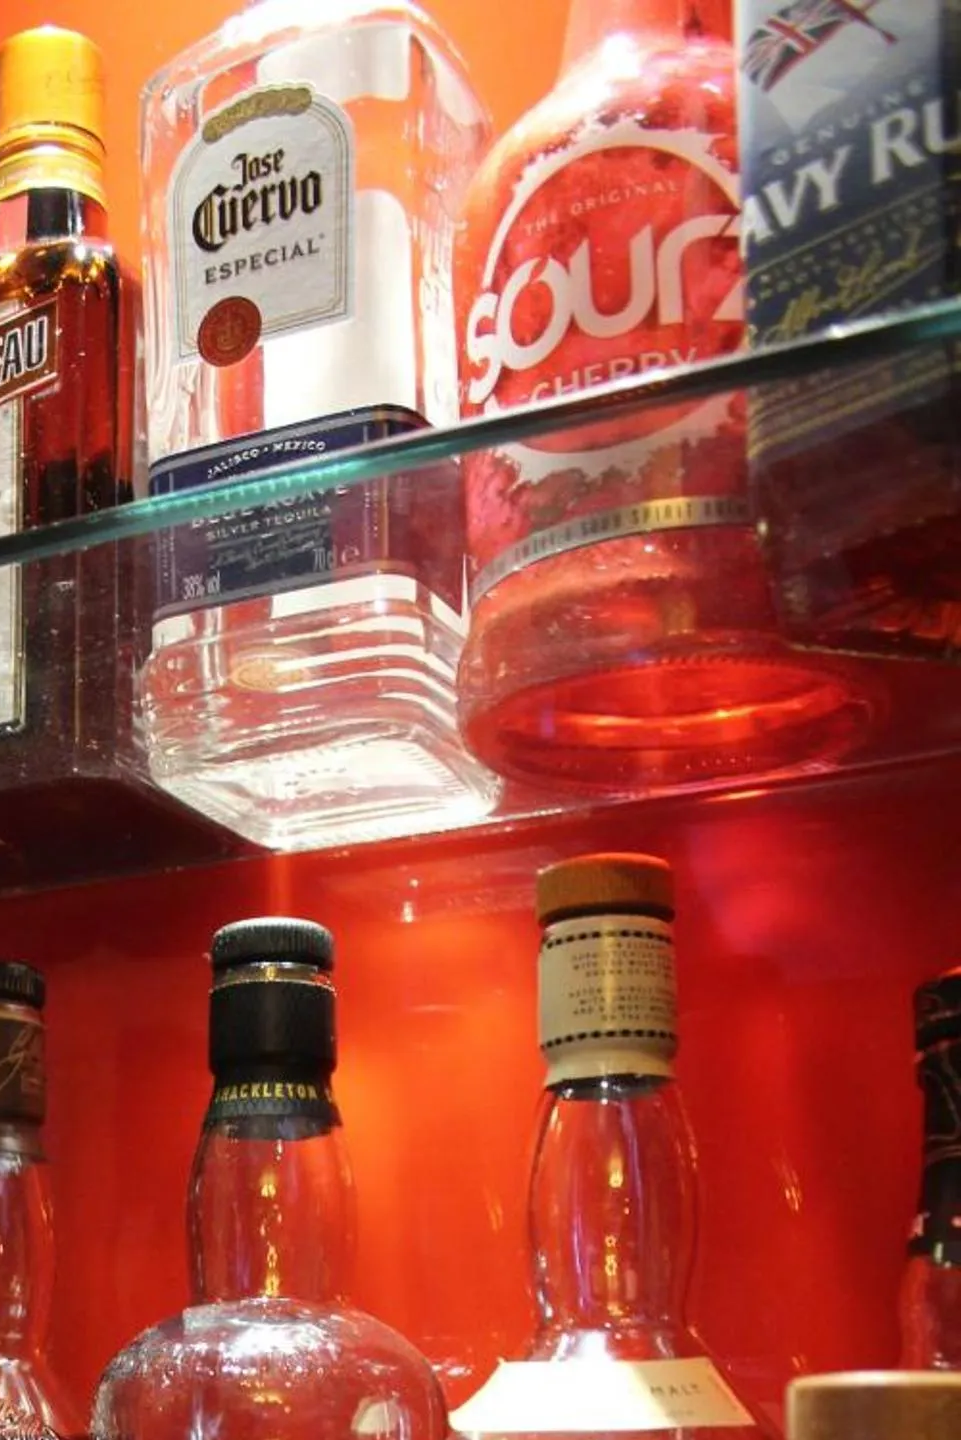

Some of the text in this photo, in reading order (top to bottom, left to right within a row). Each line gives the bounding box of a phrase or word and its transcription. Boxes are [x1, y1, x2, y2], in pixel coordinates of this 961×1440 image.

[770, 78, 927, 166] GENUINE
[740, 98, 961, 260] AVY RU
[192, 170, 322, 253] Cuervo
[524, 180, 677, 237] THE ORIGINAL
[205, 238, 321, 285] ESPECIAL
[206, 447, 259, 479] JALISCO
[265, 505, 333, 528] TEQUILA
[651, 1384, 700, 1397] MALT
